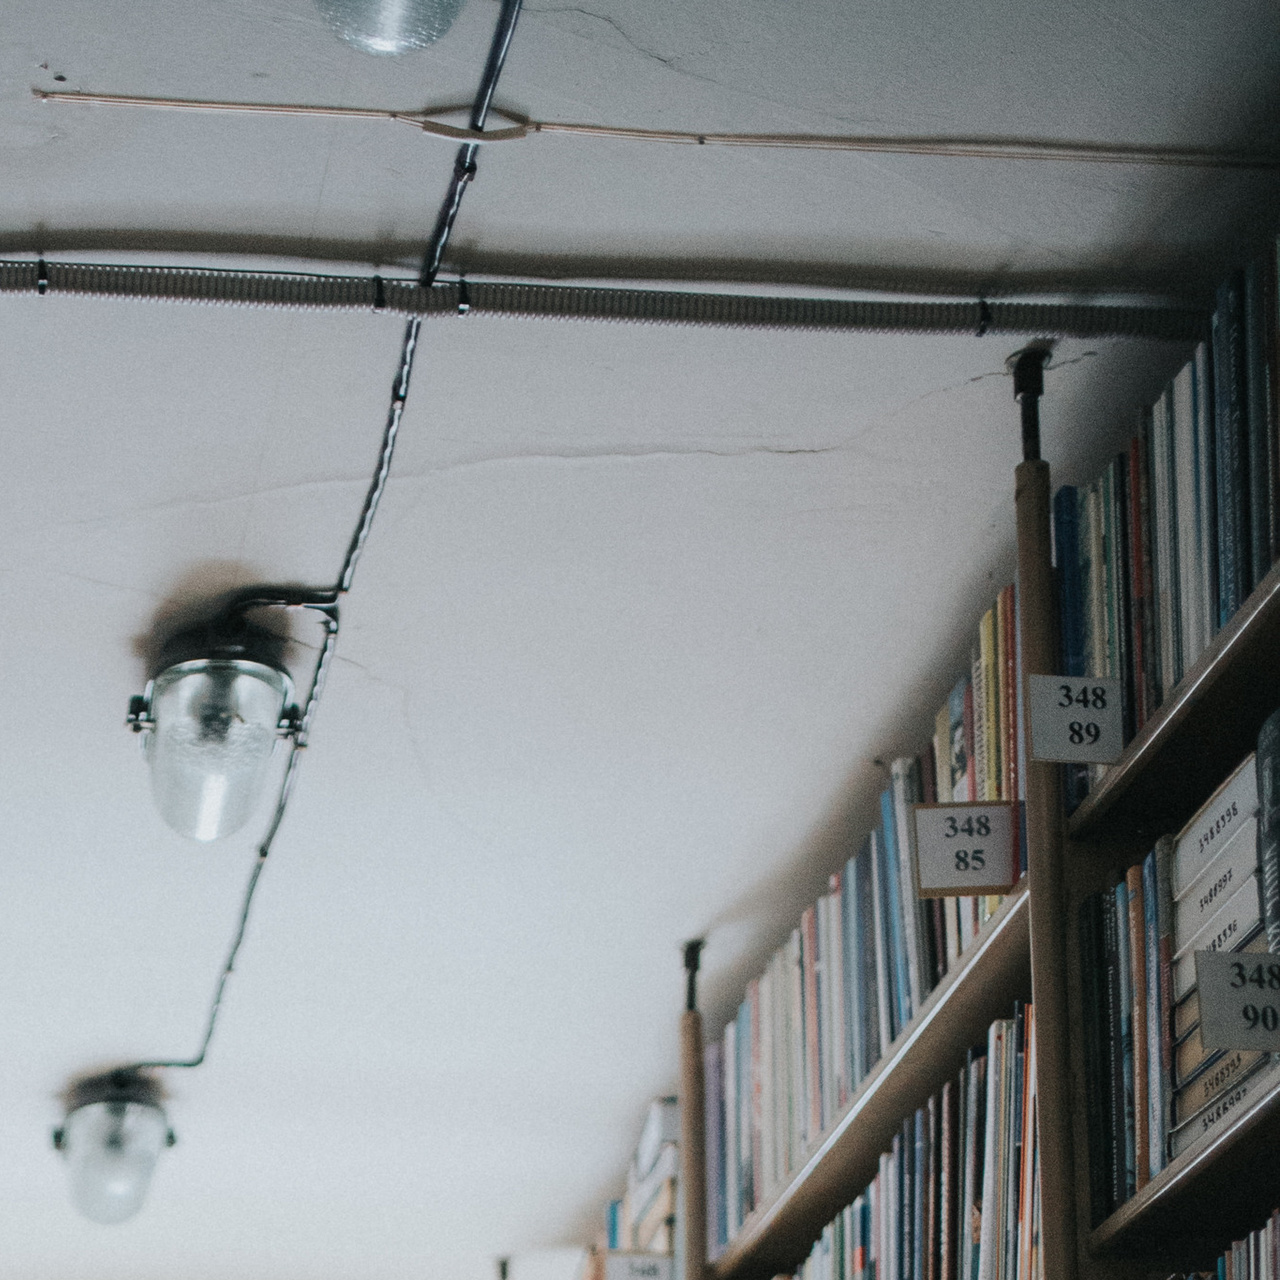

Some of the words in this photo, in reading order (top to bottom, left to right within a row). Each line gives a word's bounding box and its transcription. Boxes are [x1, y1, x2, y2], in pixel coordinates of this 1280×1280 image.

[1058, 684, 1107, 710] 348
[1068, 720, 1101, 746] 89
[943, 815, 991, 840] 348
[954, 847, 986, 872] 85
[1230, 962, 1280, 990] 348
[1243, 1004, 1278, 1031] 90
